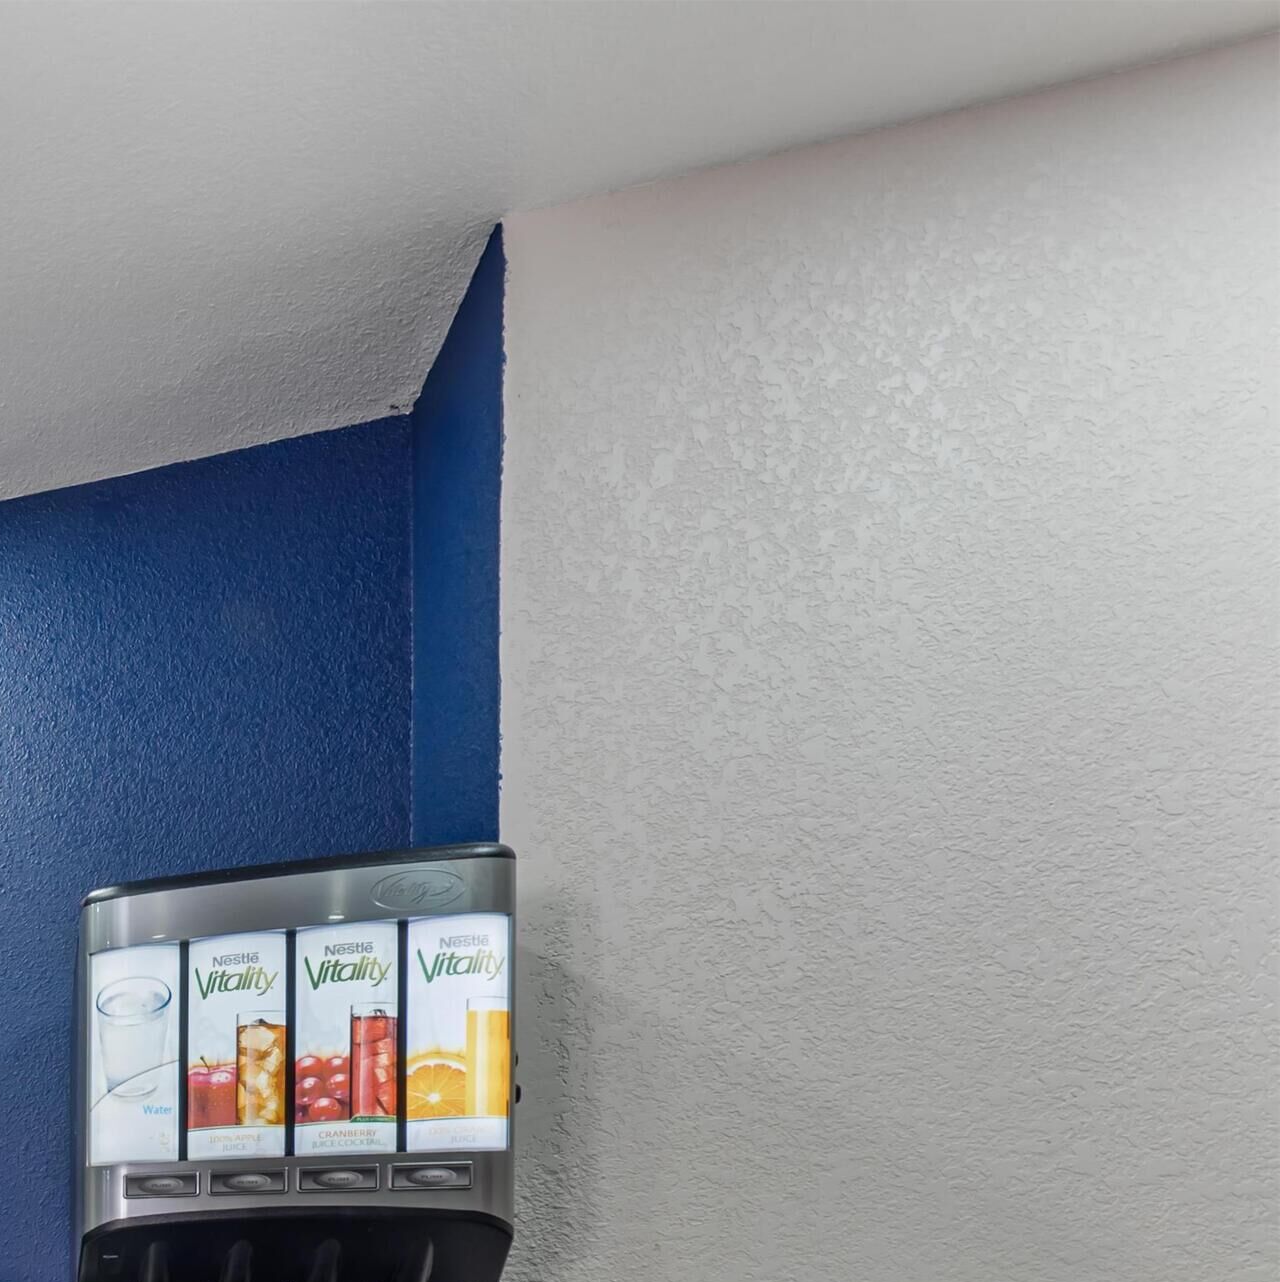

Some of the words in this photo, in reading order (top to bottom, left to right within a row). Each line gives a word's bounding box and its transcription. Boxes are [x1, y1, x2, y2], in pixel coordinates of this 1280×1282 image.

[195, 966, 278, 1000] Vitality
[304, 955, 392, 990] Vitality
[418, 948, 505, 984] Vitality
[142, 1104, 172, 1115] Water
[318, 1128, 377, 1139] CRANBERRY
